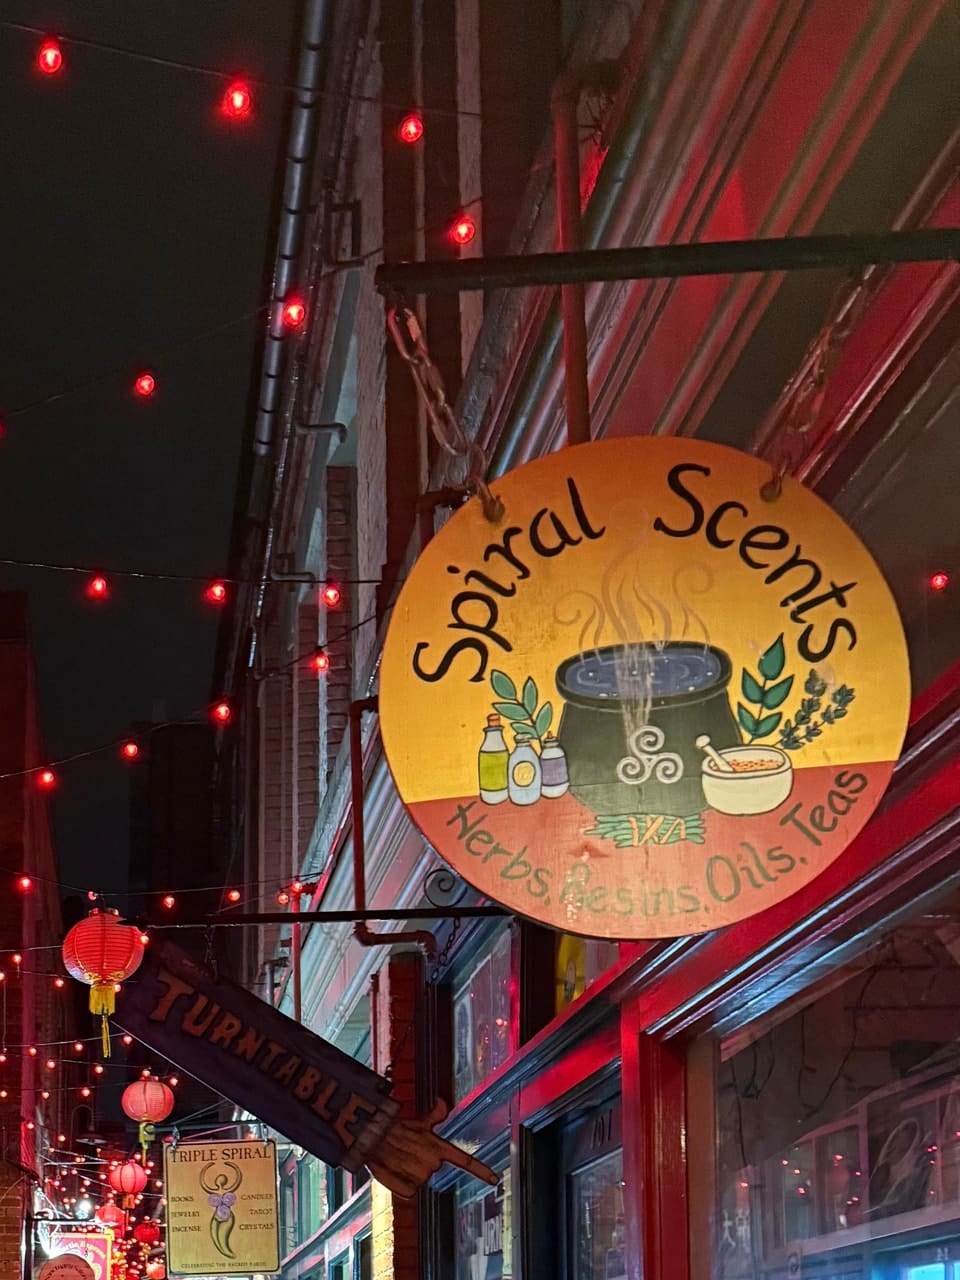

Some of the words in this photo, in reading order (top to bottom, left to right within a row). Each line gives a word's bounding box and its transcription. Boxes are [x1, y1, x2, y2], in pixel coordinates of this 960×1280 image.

[412, 477, 606, 683] Spiral
[652, 463, 858, 662] Scents
[780, 769, 868, 847] Teas
[149, 968, 377, 1148] TURNTABLE
[170, 1149, 218, 1162] TRIPLE
[222, 1148, 271, 1160] SPIRAL
